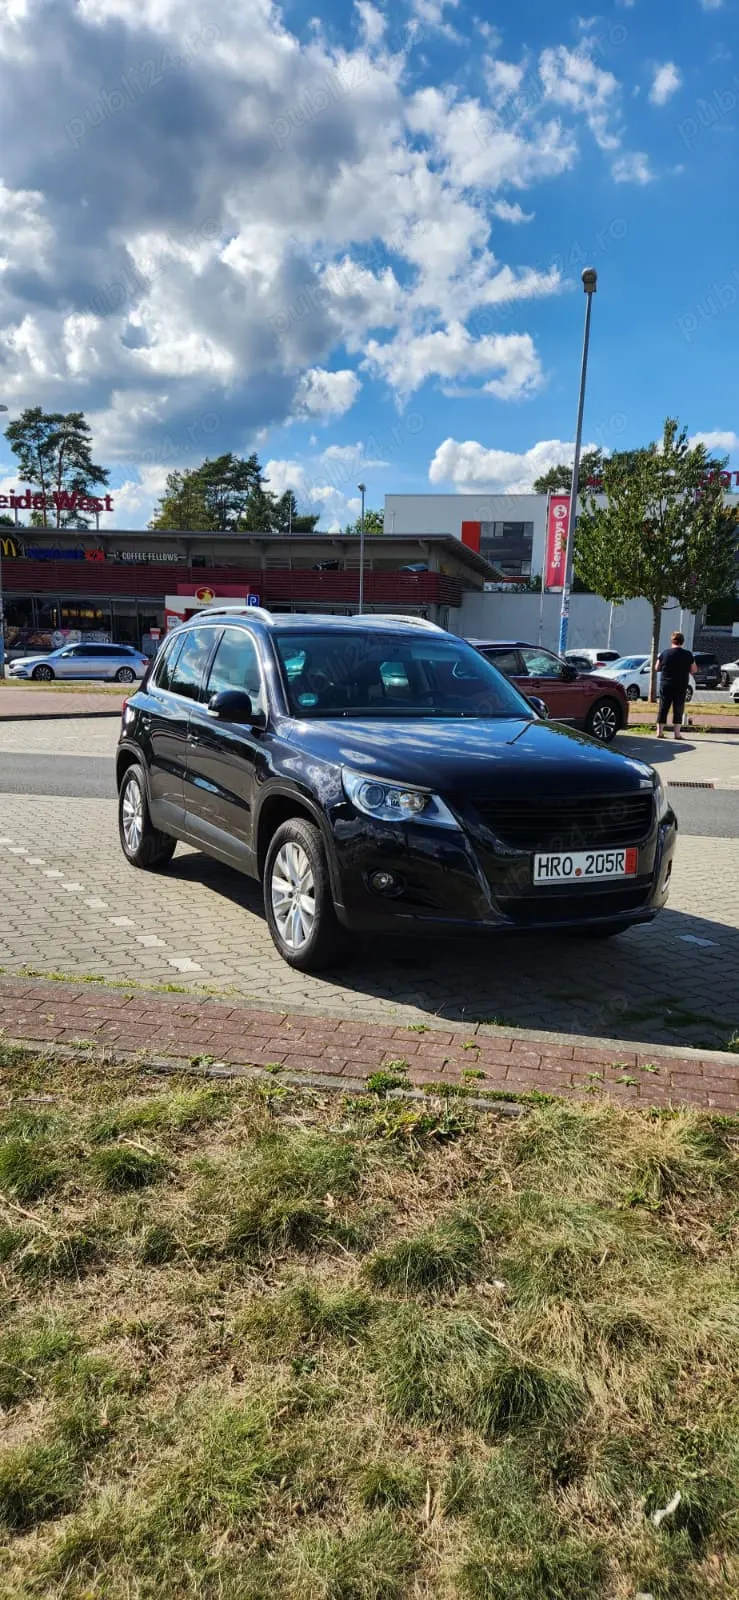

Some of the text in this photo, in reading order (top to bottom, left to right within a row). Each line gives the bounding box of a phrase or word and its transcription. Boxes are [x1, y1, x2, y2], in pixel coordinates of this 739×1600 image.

[53, 490, 113, 512] West
[551, 521, 565, 568] Serways
[122, 551, 178, 562] COFFEE FELLOWS
[538, 856, 573, 877] HRO
[584, 852, 625, 874] 205R
